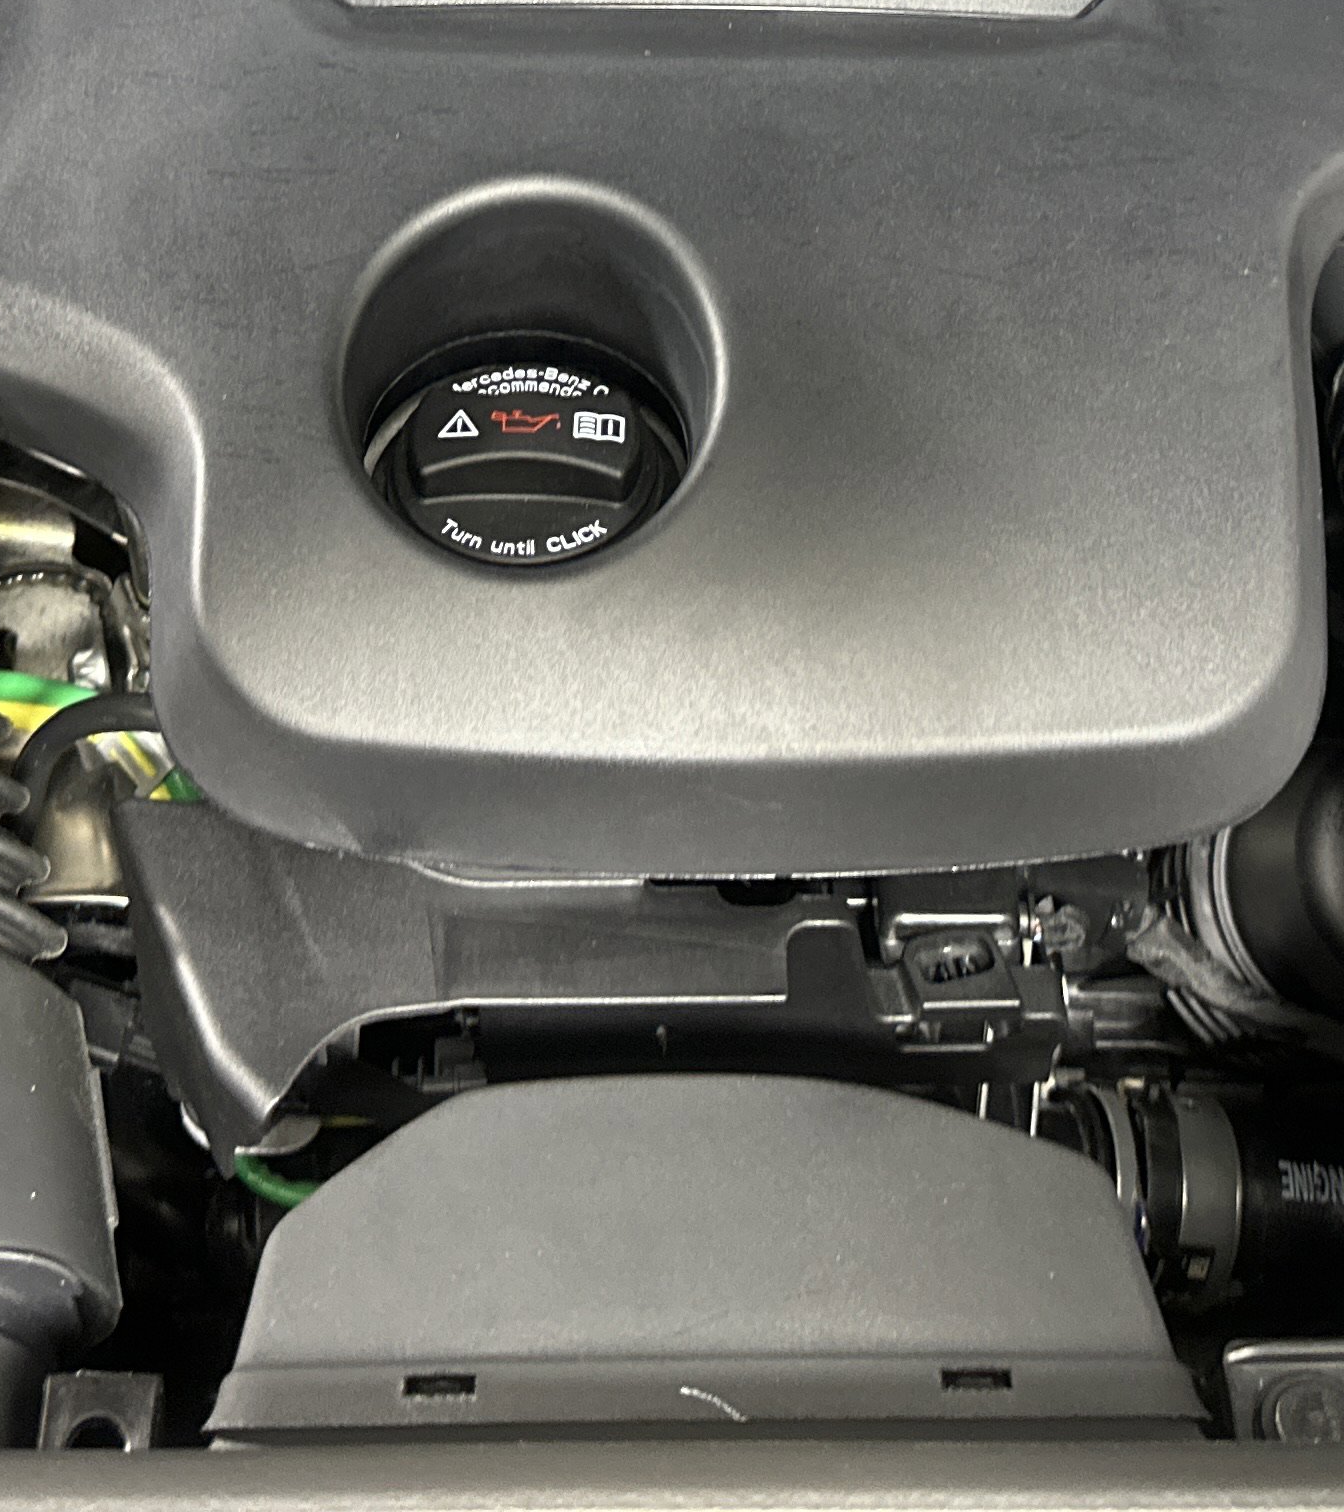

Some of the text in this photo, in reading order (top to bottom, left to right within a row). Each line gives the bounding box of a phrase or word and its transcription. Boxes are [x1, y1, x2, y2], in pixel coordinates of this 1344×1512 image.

[441, 517, 608, 556] Turn until CLICK
